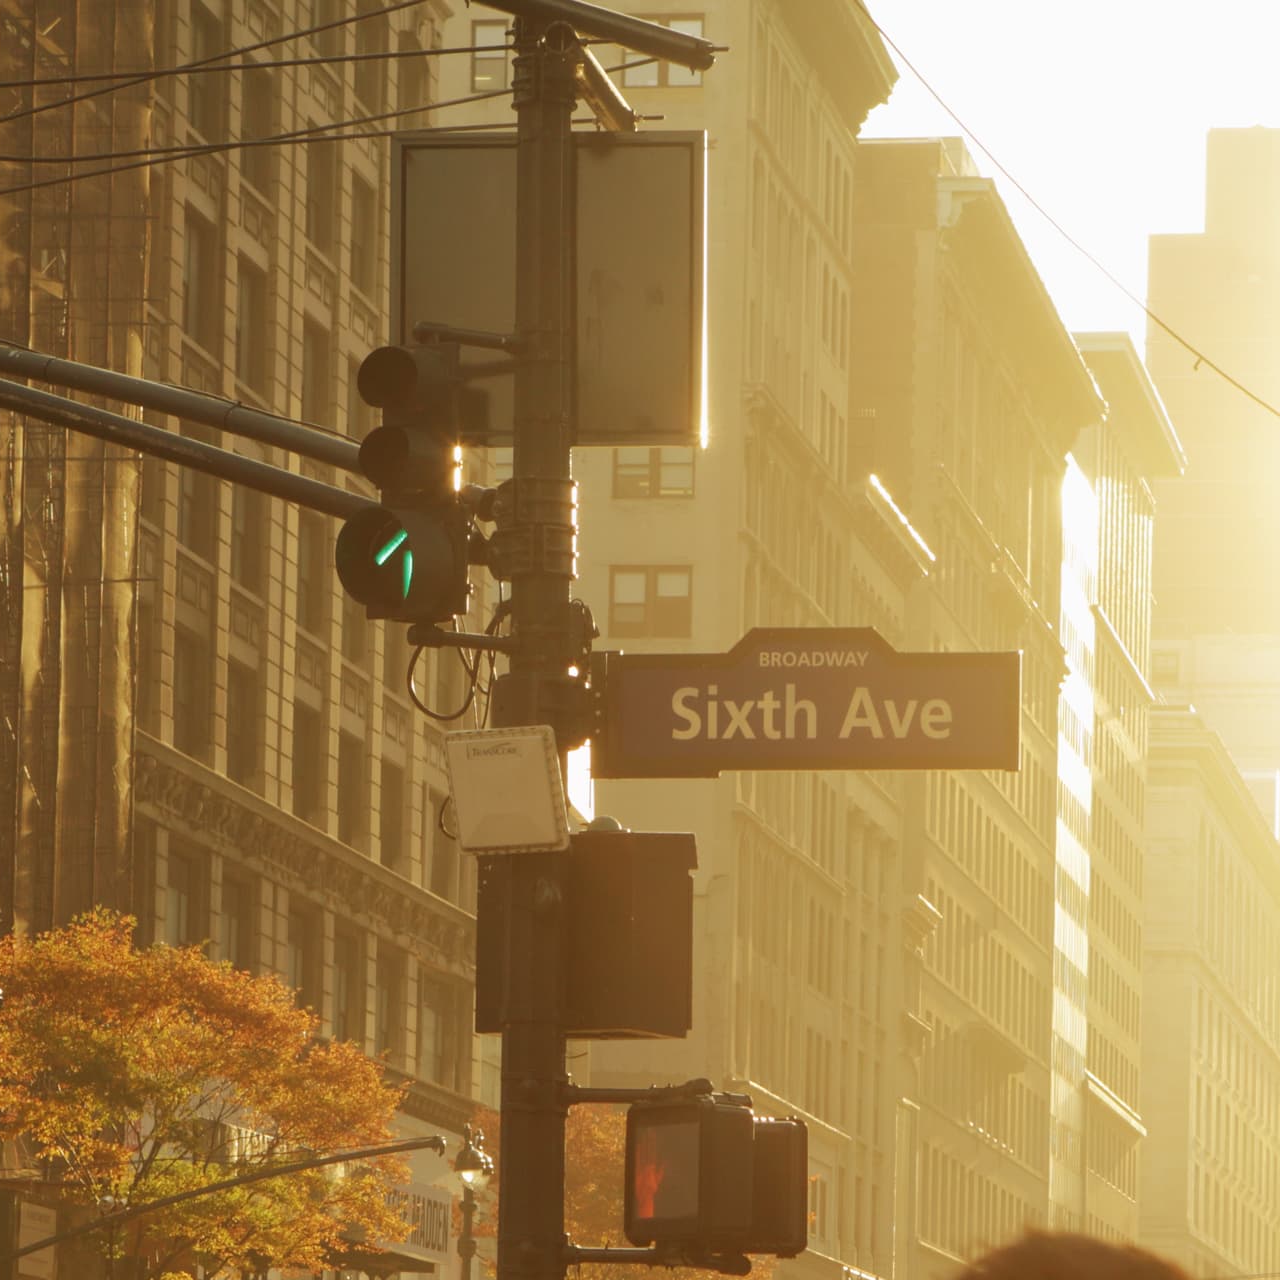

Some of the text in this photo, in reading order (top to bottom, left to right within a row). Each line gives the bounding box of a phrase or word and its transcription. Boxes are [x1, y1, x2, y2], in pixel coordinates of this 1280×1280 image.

[759, 651, 869, 667] BROADWAY
[671, 683, 953, 740] Sixth Ave
